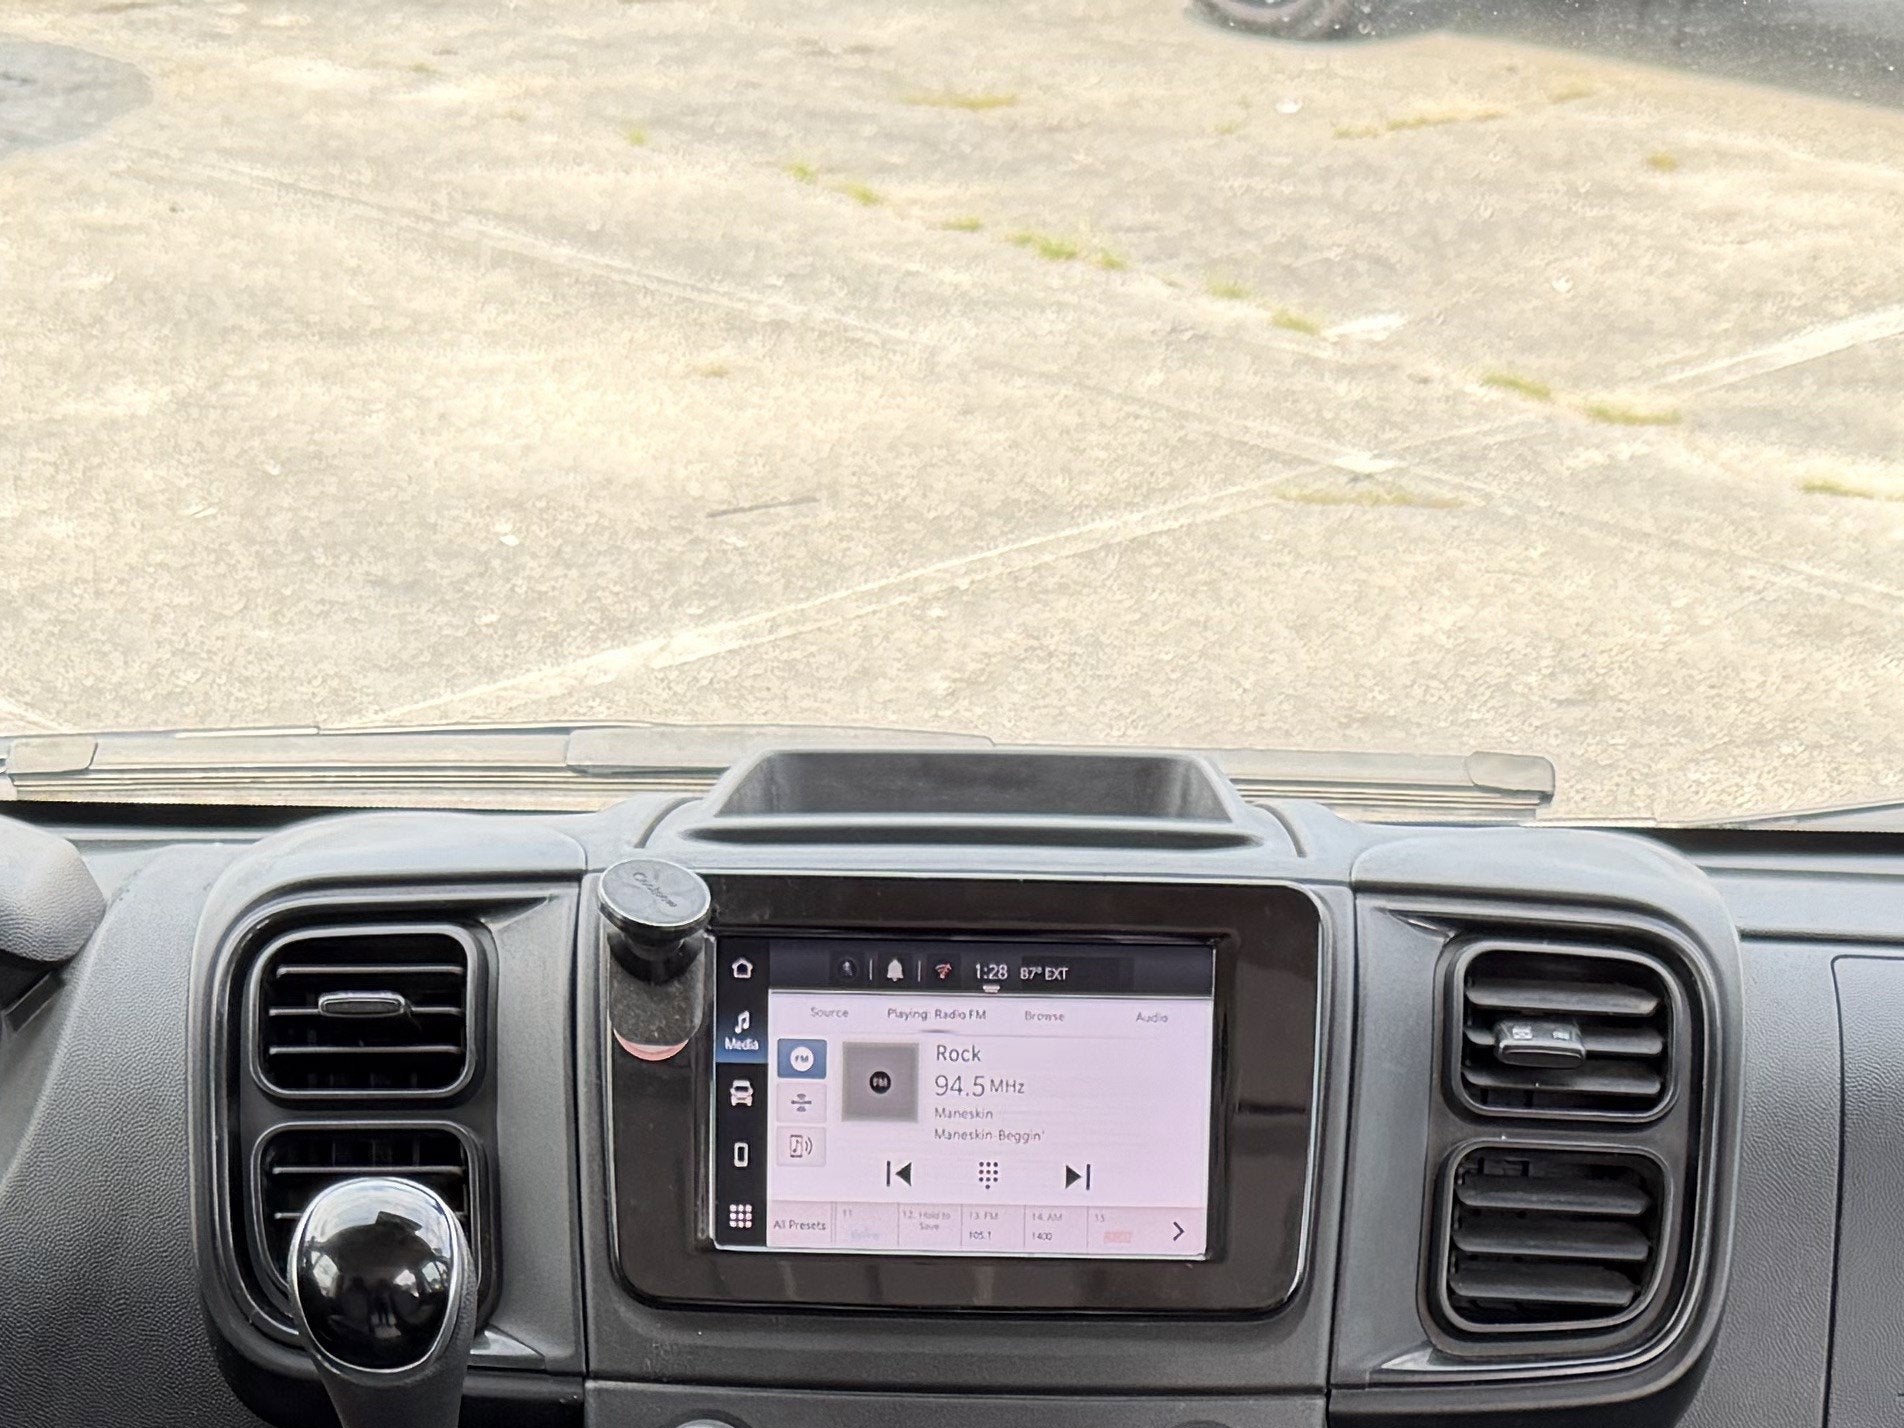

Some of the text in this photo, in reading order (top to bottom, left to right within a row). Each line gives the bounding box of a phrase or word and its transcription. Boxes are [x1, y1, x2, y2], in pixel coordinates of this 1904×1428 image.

[975, 963, 1008, 980] 1:28
[1045, 967, 1069, 981] EXT
[810, 1007, 849, 1019] Source
[934, 1008, 967, 1020] Radio
[968, 1009, 987, 1020] FM
[1024, 1010, 1065, 1022] Browse
[1135, 1011, 1169, 1023] Audio
[724, 1037, 760, 1051] Media
[936, 1044, 982, 1062] Rock
[871, 1077, 889, 1088] FM
[934, 1074, 1025, 1097] 94.5 MHz
[934, 1107, 993, 1120] Maneskin
[934, 1128, 993, 1141] Maneskin
[998, 1129, 1045, 1144] Beggin'
[788, 1219, 826, 1231] Presets
